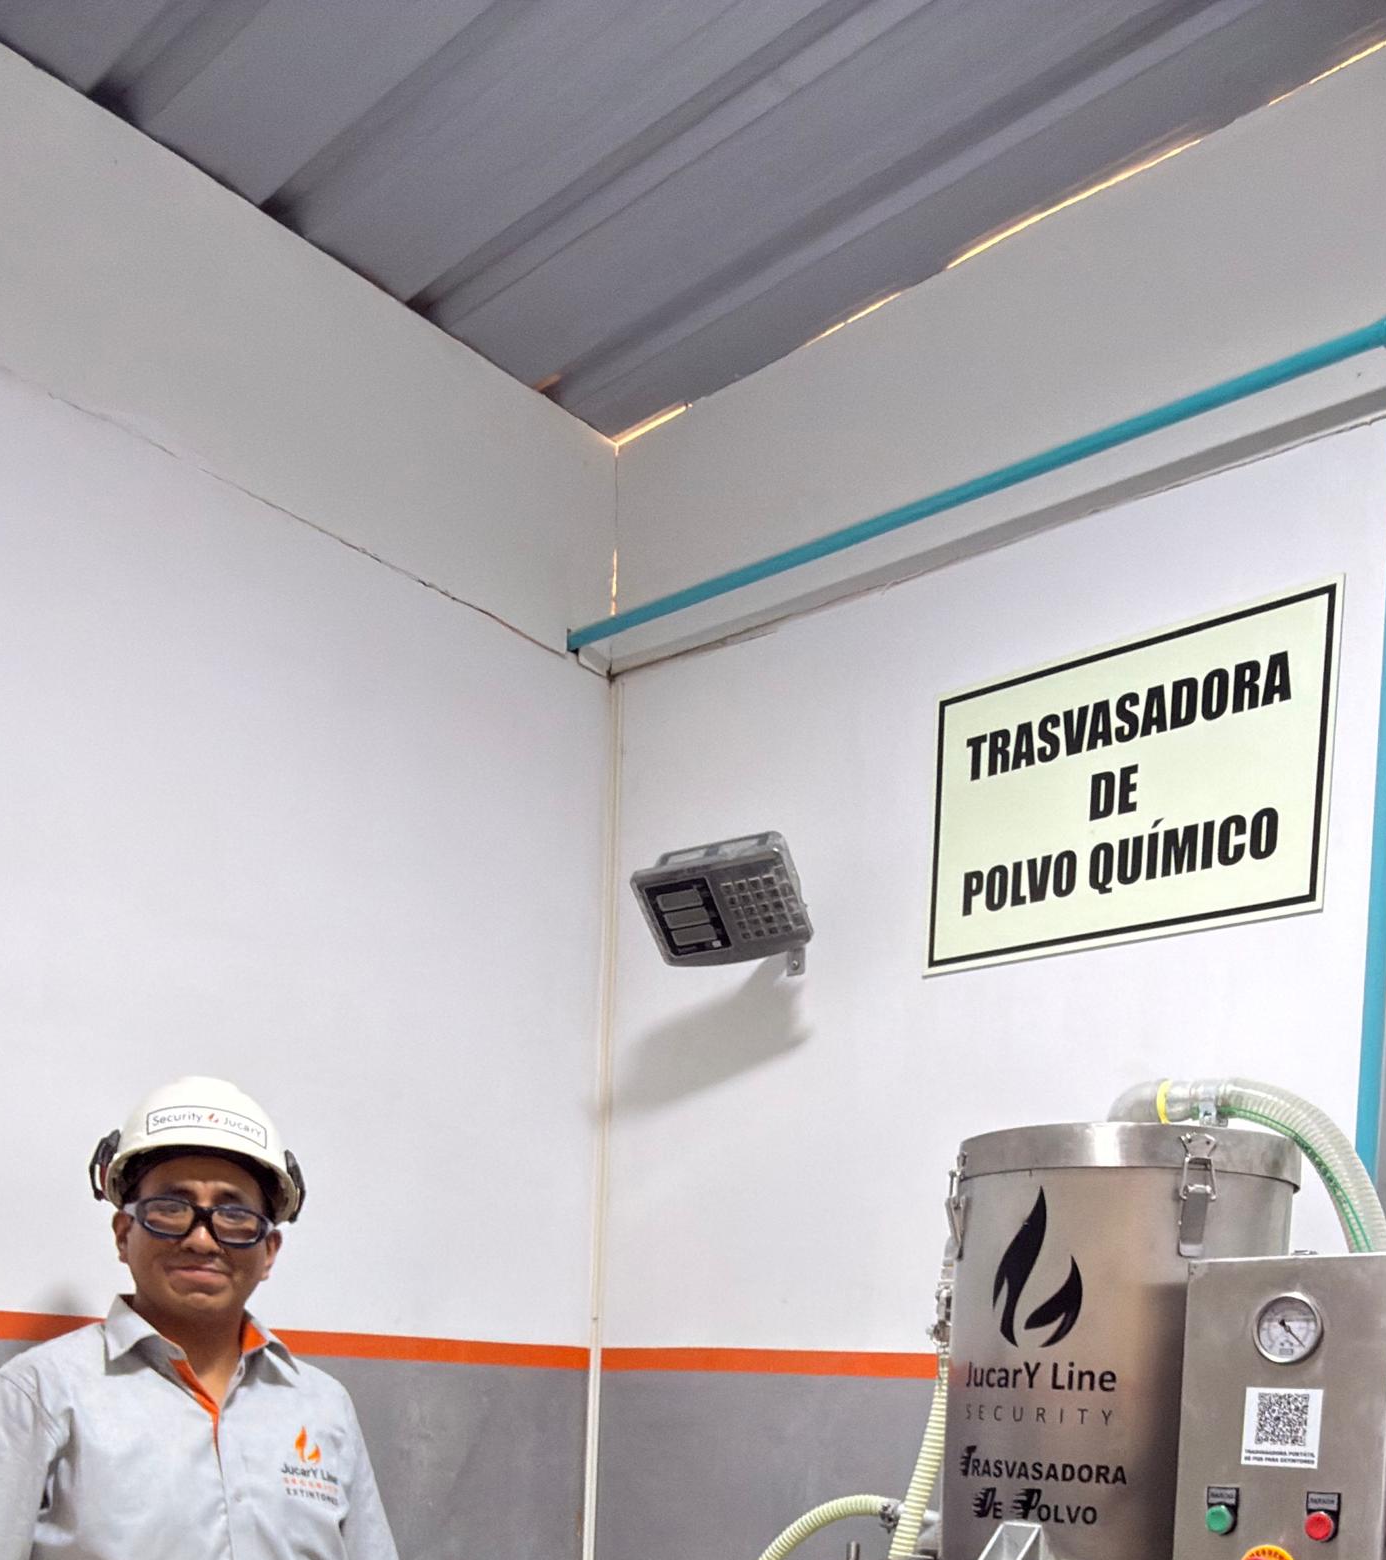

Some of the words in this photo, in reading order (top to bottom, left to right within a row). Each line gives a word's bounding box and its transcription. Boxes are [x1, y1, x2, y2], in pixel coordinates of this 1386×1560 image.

[966, 650, 1292, 781] TRASVASADORA
[1089, 764, 1139, 821] DE
[962, 849, 1078, 917] POLVO
[1088, 806, 1279, 895] QUÍMICO
[152, 1111, 203, 1127] Security
[966, 1361, 1041, 1389] JucarY
[1051, 1362, 1117, 1392] Line
[965, 1404, 1113, 1426] SECURITY
